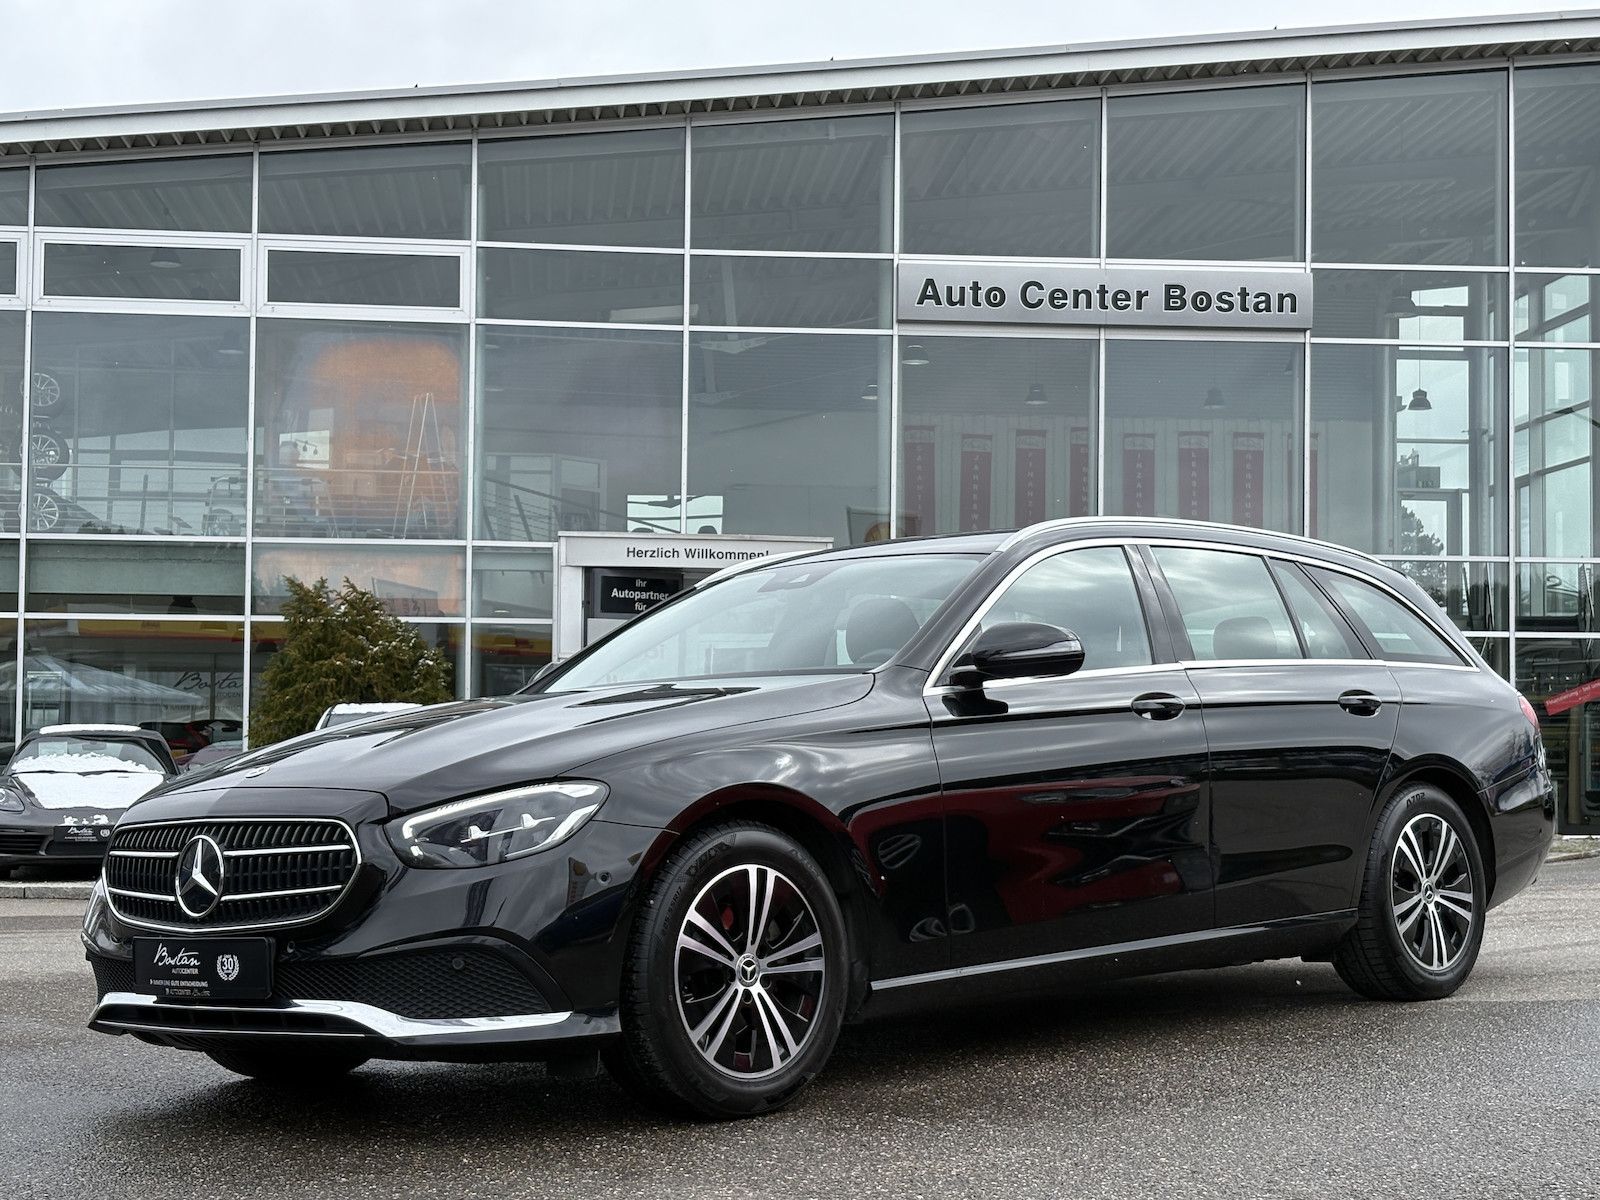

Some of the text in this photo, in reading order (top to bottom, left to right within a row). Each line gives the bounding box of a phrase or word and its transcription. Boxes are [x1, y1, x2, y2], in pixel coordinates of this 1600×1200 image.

[915, 278, 1298, 314] Auto Center Bostan
[626, 546, 680, 559] Herzlich
[635, 579, 647, 588] Ihr
[611, 588, 669, 600] Autopartner
[634, 602, 647, 611] für
[173, 671, 243, 690] Bosta
[153, 942, 200, 966] Bostan
[221, 957, 234, 970] 30
